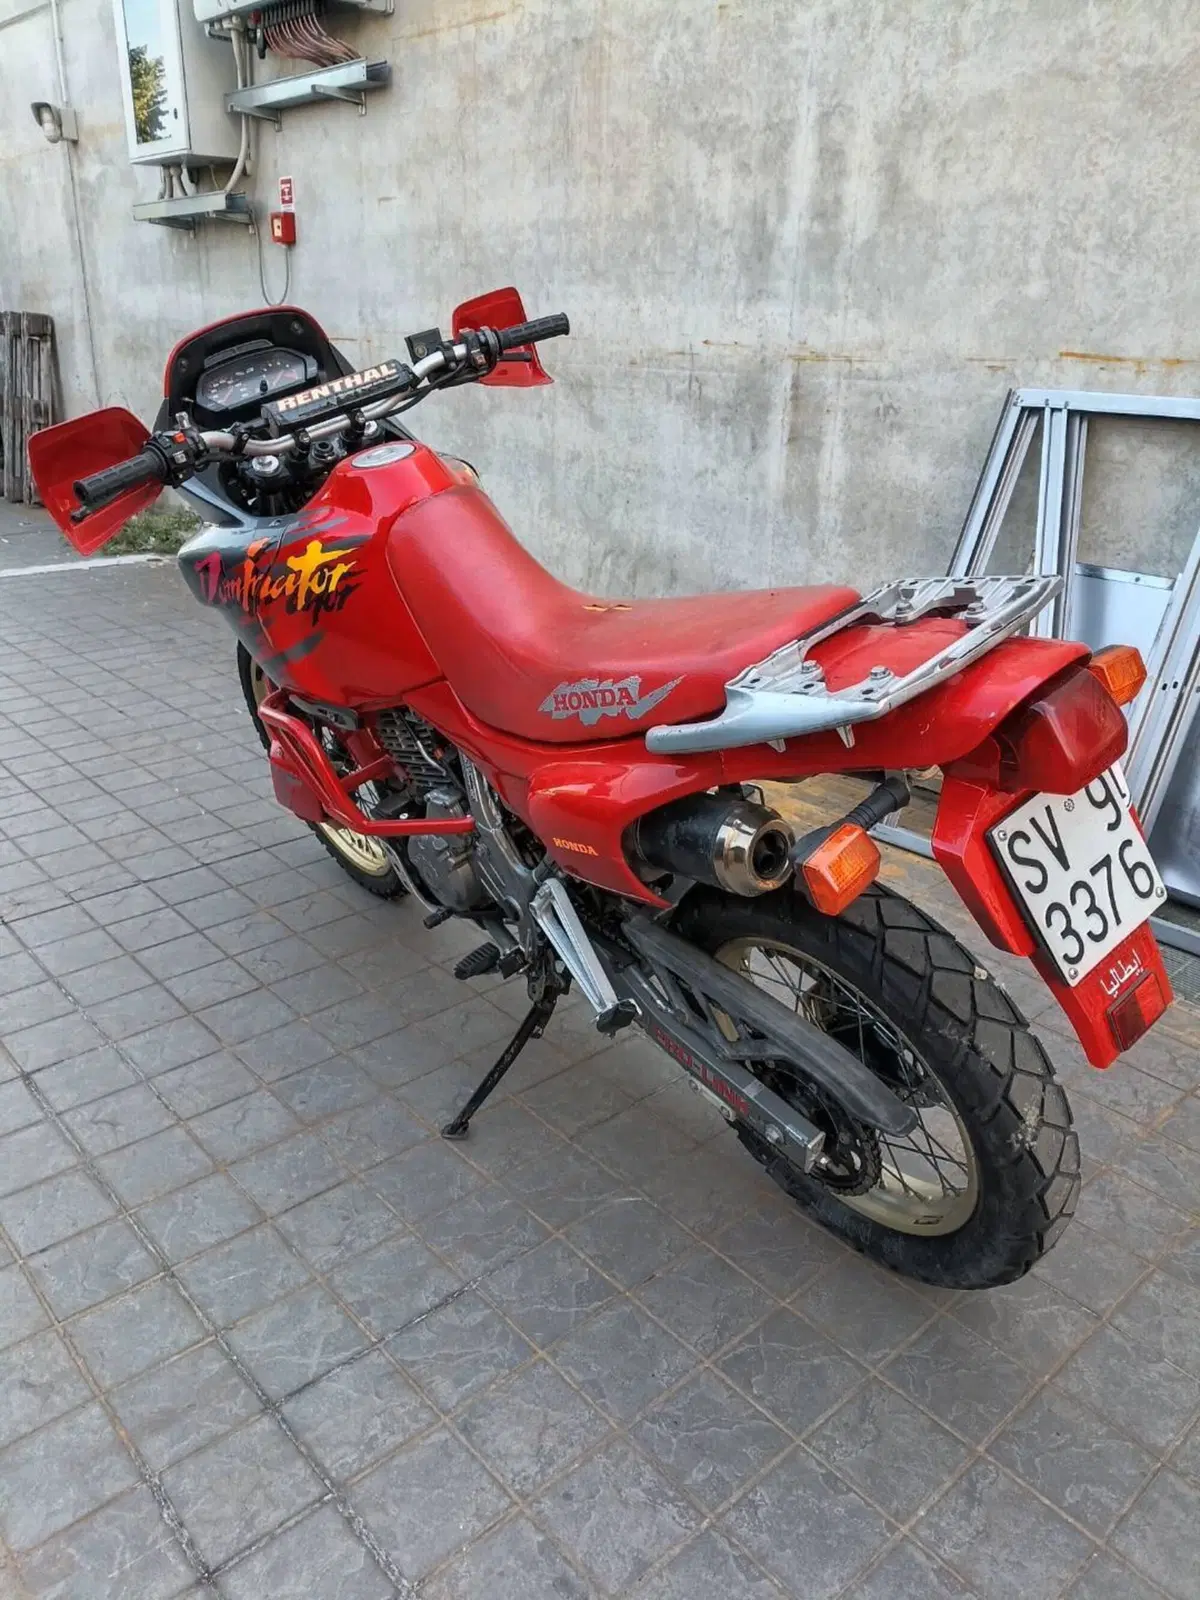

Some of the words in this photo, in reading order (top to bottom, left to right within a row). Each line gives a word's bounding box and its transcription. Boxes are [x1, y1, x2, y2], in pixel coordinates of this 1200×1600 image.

[276, 363, 397, 412] RENTHAL
[553, 687, 637, 712] HONDA
[552, 837, 599, 856] HONDA
[1007, 805, 1070, 894] SV
[1045, 839, 1154, 965] 3376
